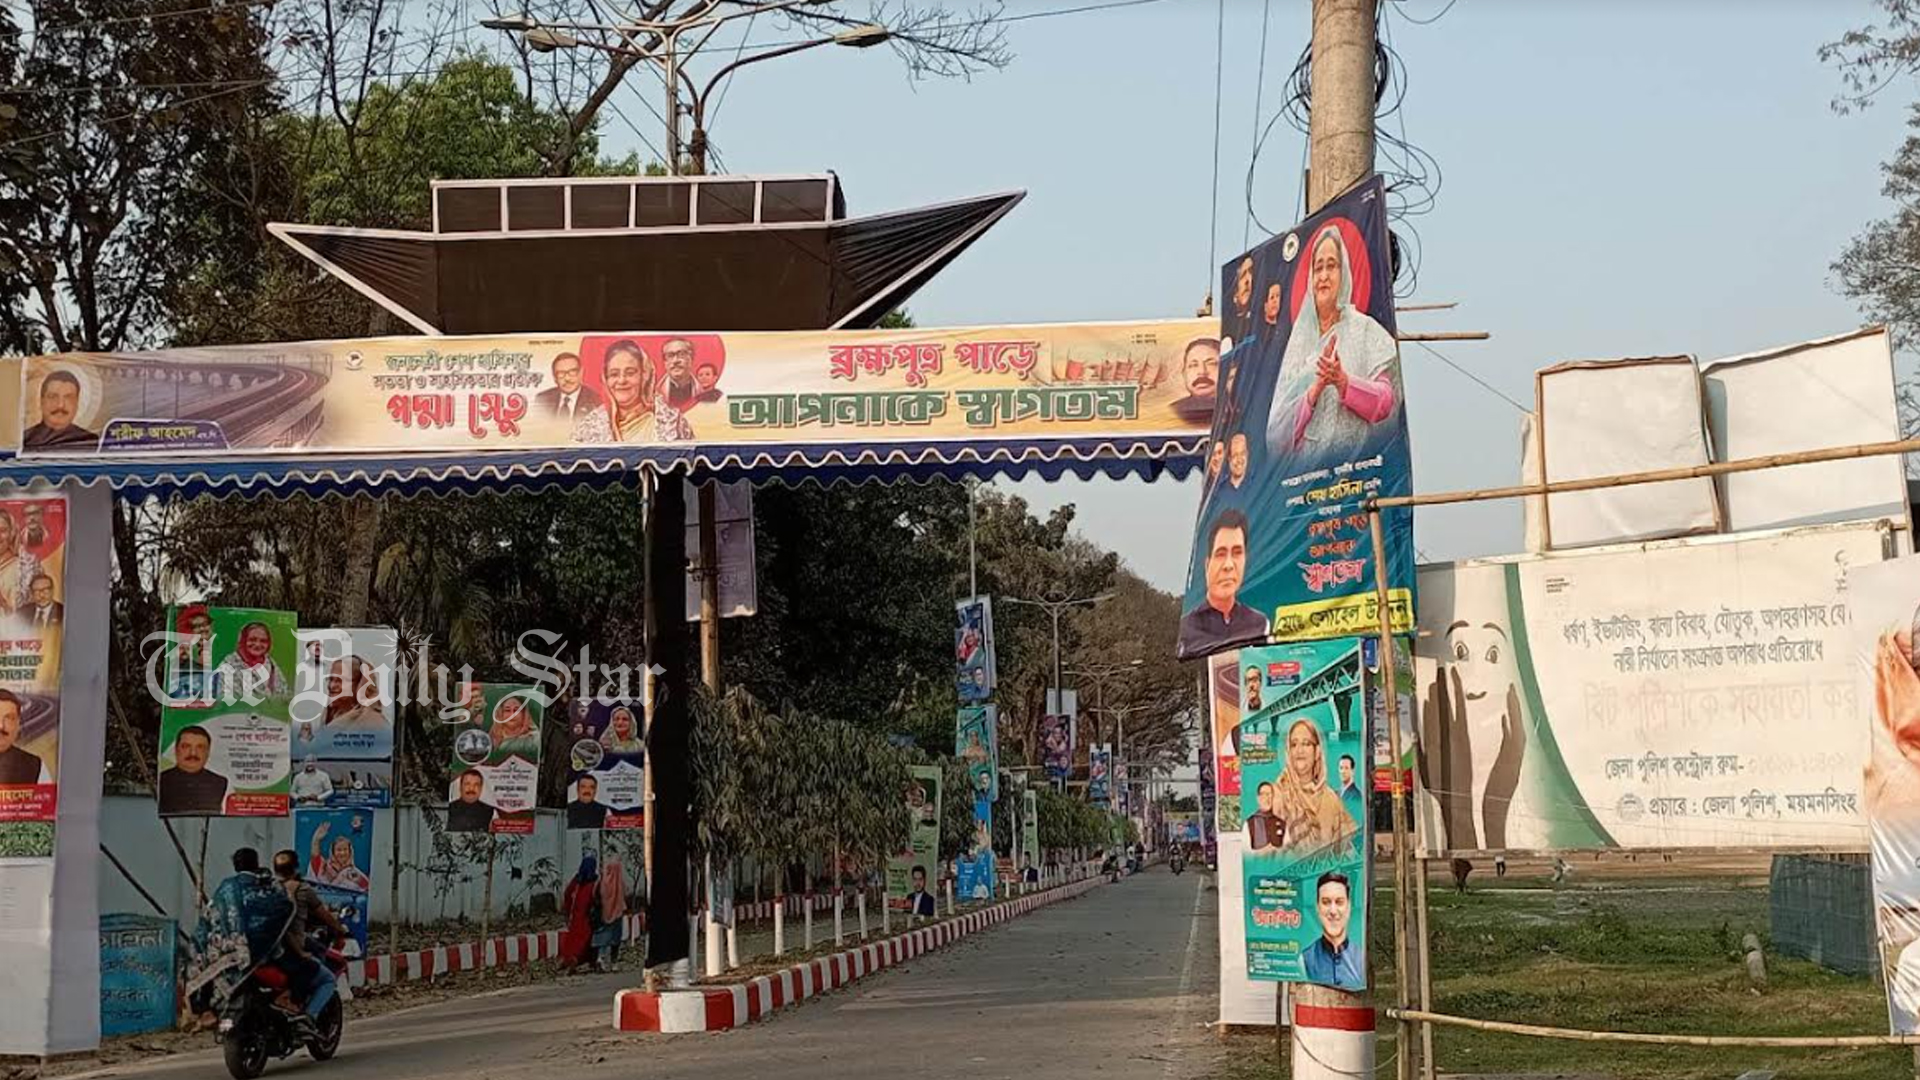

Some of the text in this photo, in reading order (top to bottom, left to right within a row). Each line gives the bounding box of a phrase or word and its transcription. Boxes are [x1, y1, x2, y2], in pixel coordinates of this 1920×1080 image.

[953, 341, 1041, 381] পাড়ে
[386, 392, 528, 440] পদ্মা সেতু
[727, 385, 1142, 428] আপনাকে স্বাগতম
[1714, 604, 1758, 639] যৌতুক,
[1768, 635, 1825, 663] প্রতিরোধে
[1605, 758, 1634, 780] জেলা
[1637, 751, 1669, 783] পুলিশ
[1649, 796, 1687, 817] প্রচারে
[1702, 795, 1735, 816] জেলা
